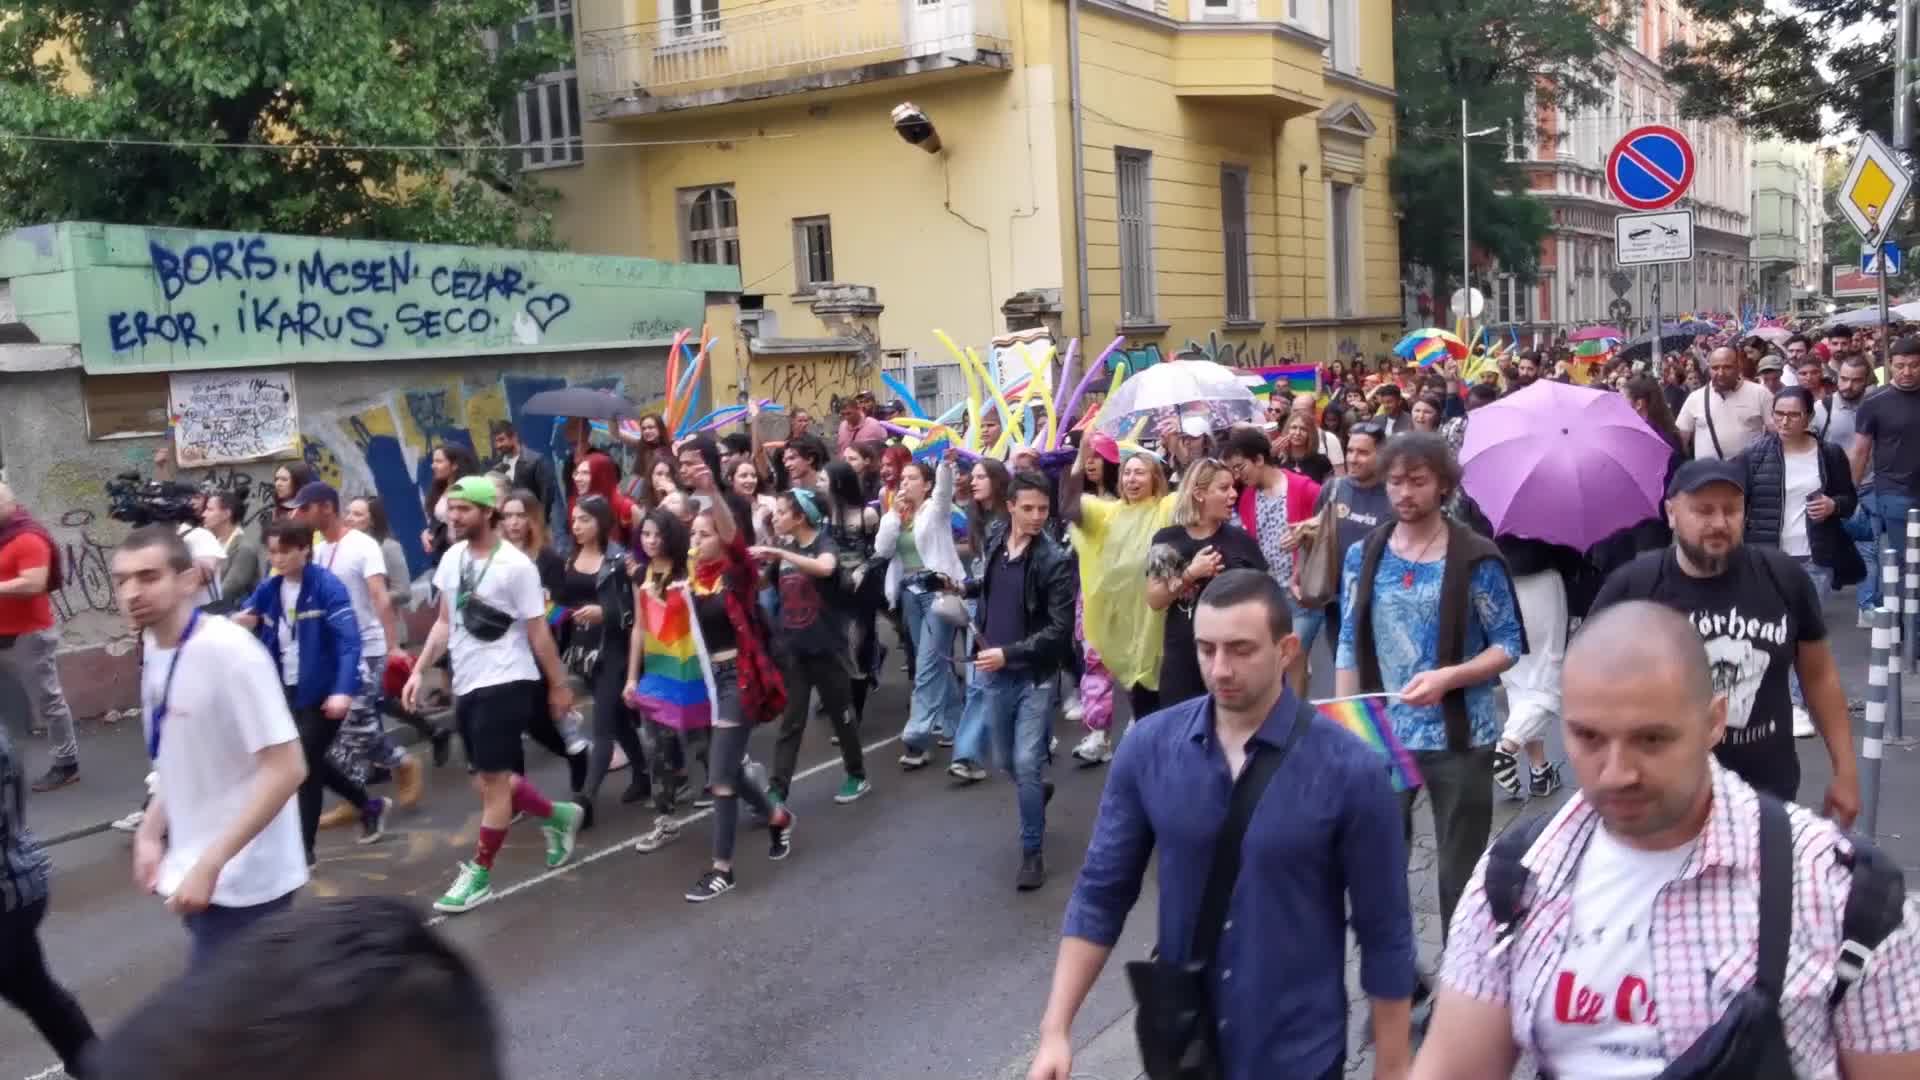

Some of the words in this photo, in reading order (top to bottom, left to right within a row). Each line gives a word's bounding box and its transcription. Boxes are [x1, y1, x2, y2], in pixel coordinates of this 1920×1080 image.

[431, 264, 526, 302] CEZAR
[109, 311, 207, 351] EROR
[396, 303, 491, 338] SECO
[1555, 971, 1605, 1024] Lee
